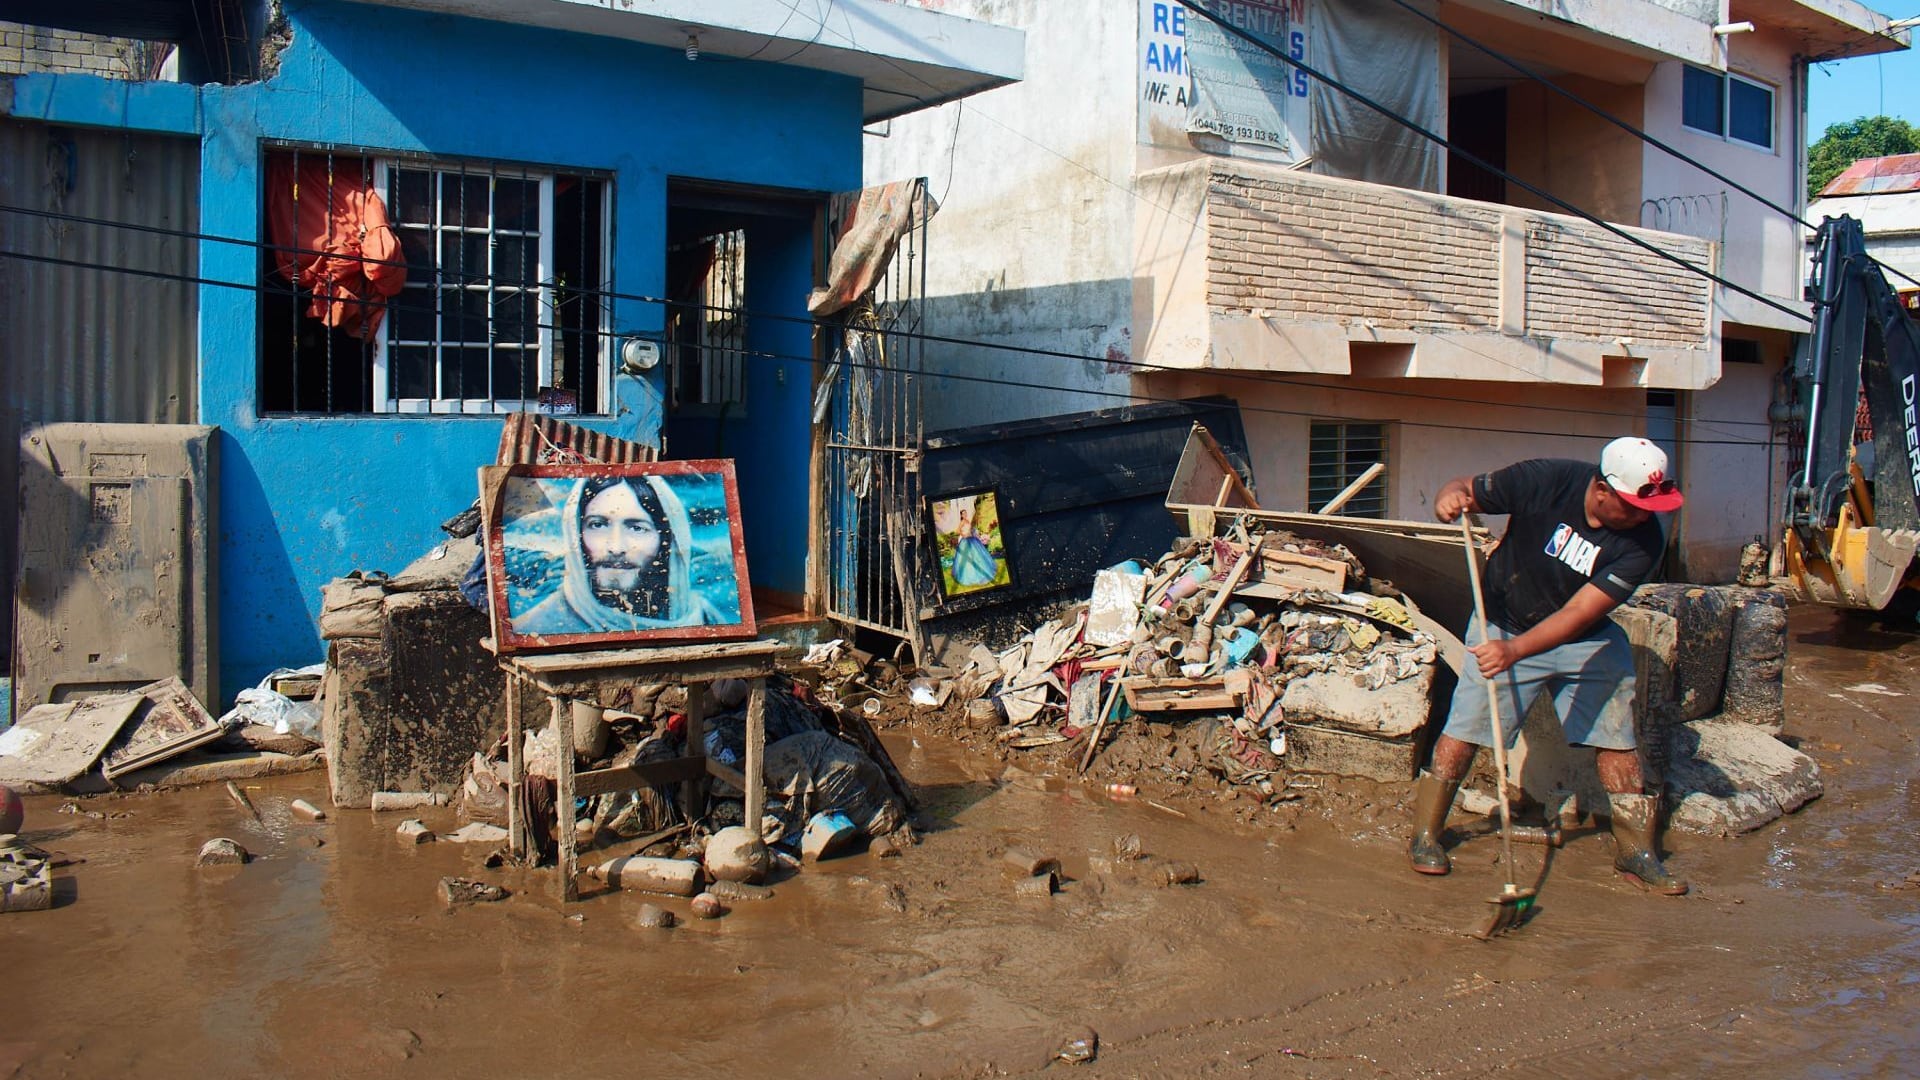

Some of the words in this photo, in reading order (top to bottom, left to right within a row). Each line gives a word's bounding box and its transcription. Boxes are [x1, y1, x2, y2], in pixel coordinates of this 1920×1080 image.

[1218, 0, 1285, 38] RENTA
[1146, 42, 1188, 76] AM
[1145, 81, 1170, 106] INF.
[1236, 126, 1253, 139] 193
[1255, 129, 1266, 141] 03
[1902, 374, 1920, 497] DEERE
[1558, 531, 1602, 577] NBA
